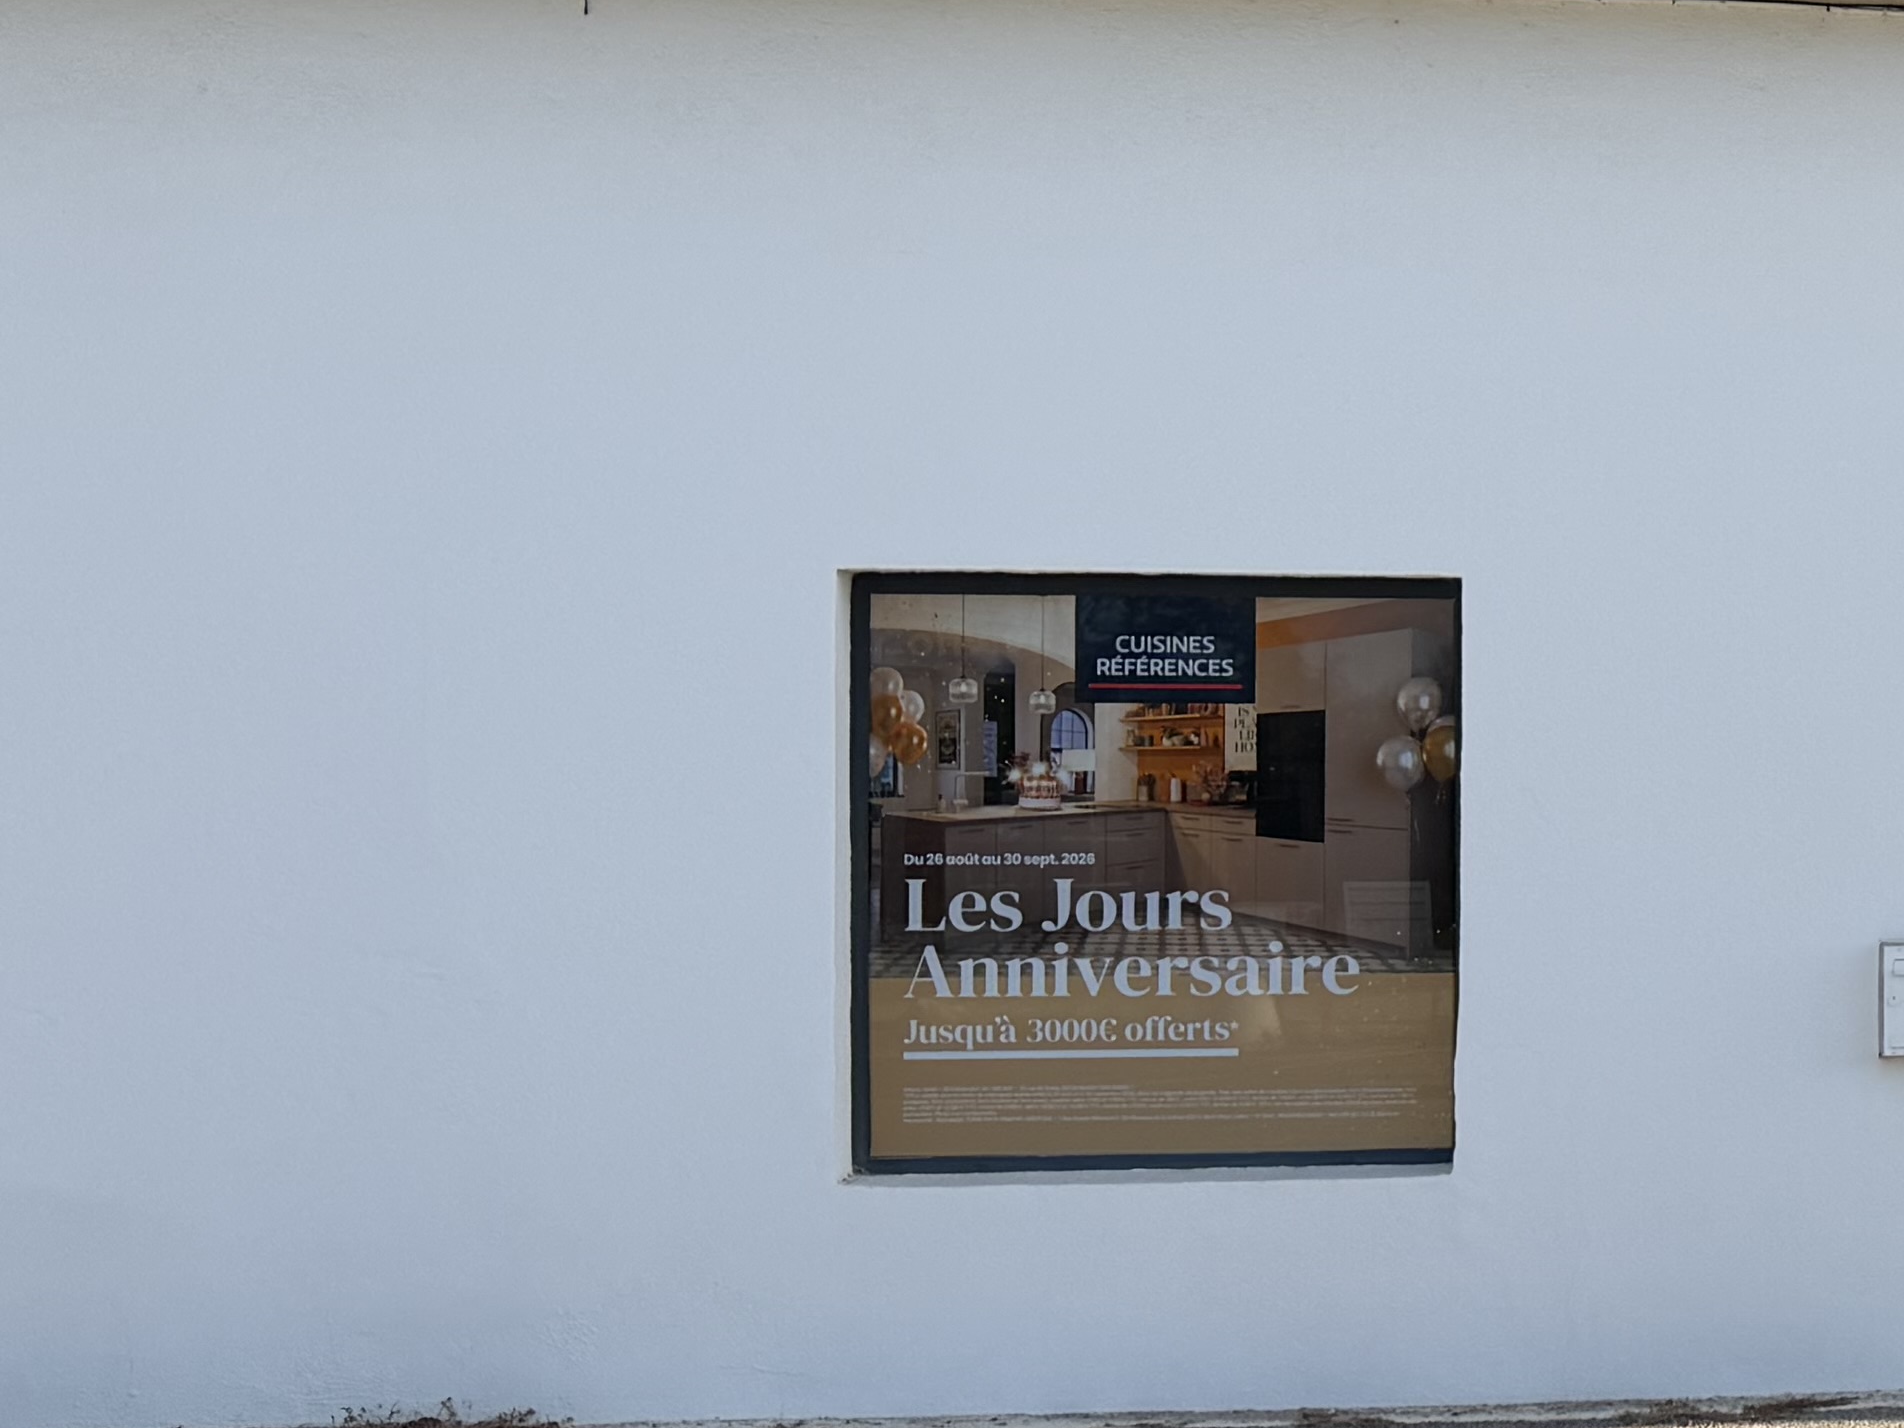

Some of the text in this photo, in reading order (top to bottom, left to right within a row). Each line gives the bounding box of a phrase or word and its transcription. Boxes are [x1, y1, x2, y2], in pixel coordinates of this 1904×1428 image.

[1114, 634, 1216, 654] CUISINES
[1095, 655, 1234, 677] RÉFÉRENCES
[903, 853, 924, 866] Du
[945, 852, 980, 866] août
[981, 854, 1001, 866] au
[1003, 852, 1022, 866] 30
[1023, 853, 1060, 869] sept.
[903, 877, 1233, 933] Les Jours
[903, 940, 1361, 1000] Anniversaire
[1025, 1017, 1118, 1043] 3000€
